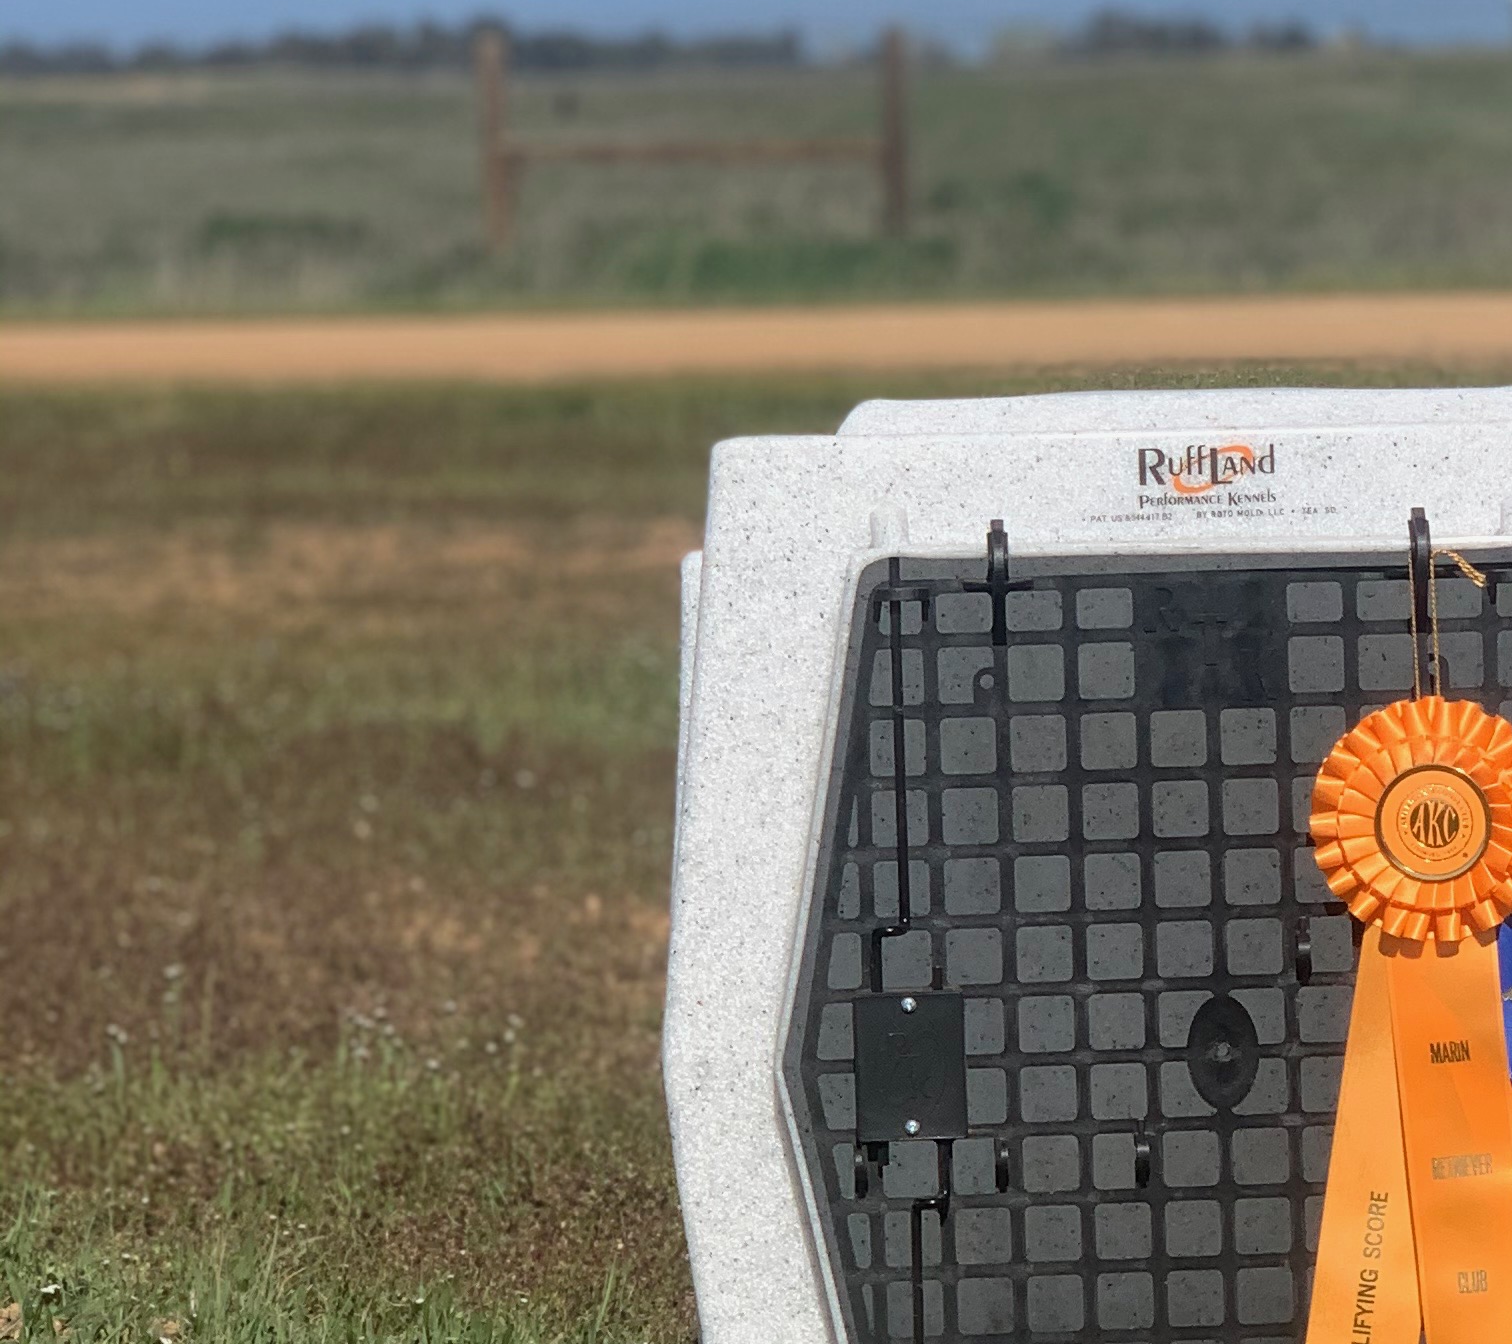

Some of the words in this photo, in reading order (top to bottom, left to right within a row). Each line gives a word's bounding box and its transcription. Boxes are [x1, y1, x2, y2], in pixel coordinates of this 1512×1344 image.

[1411, 799, 1458, 847] AKC
[1430, 1040, 1471, 1064] MARIN
[1363, 1190, 1389, 1260] SCORE
[1457, 1269, 1488, 1294] CLUB
